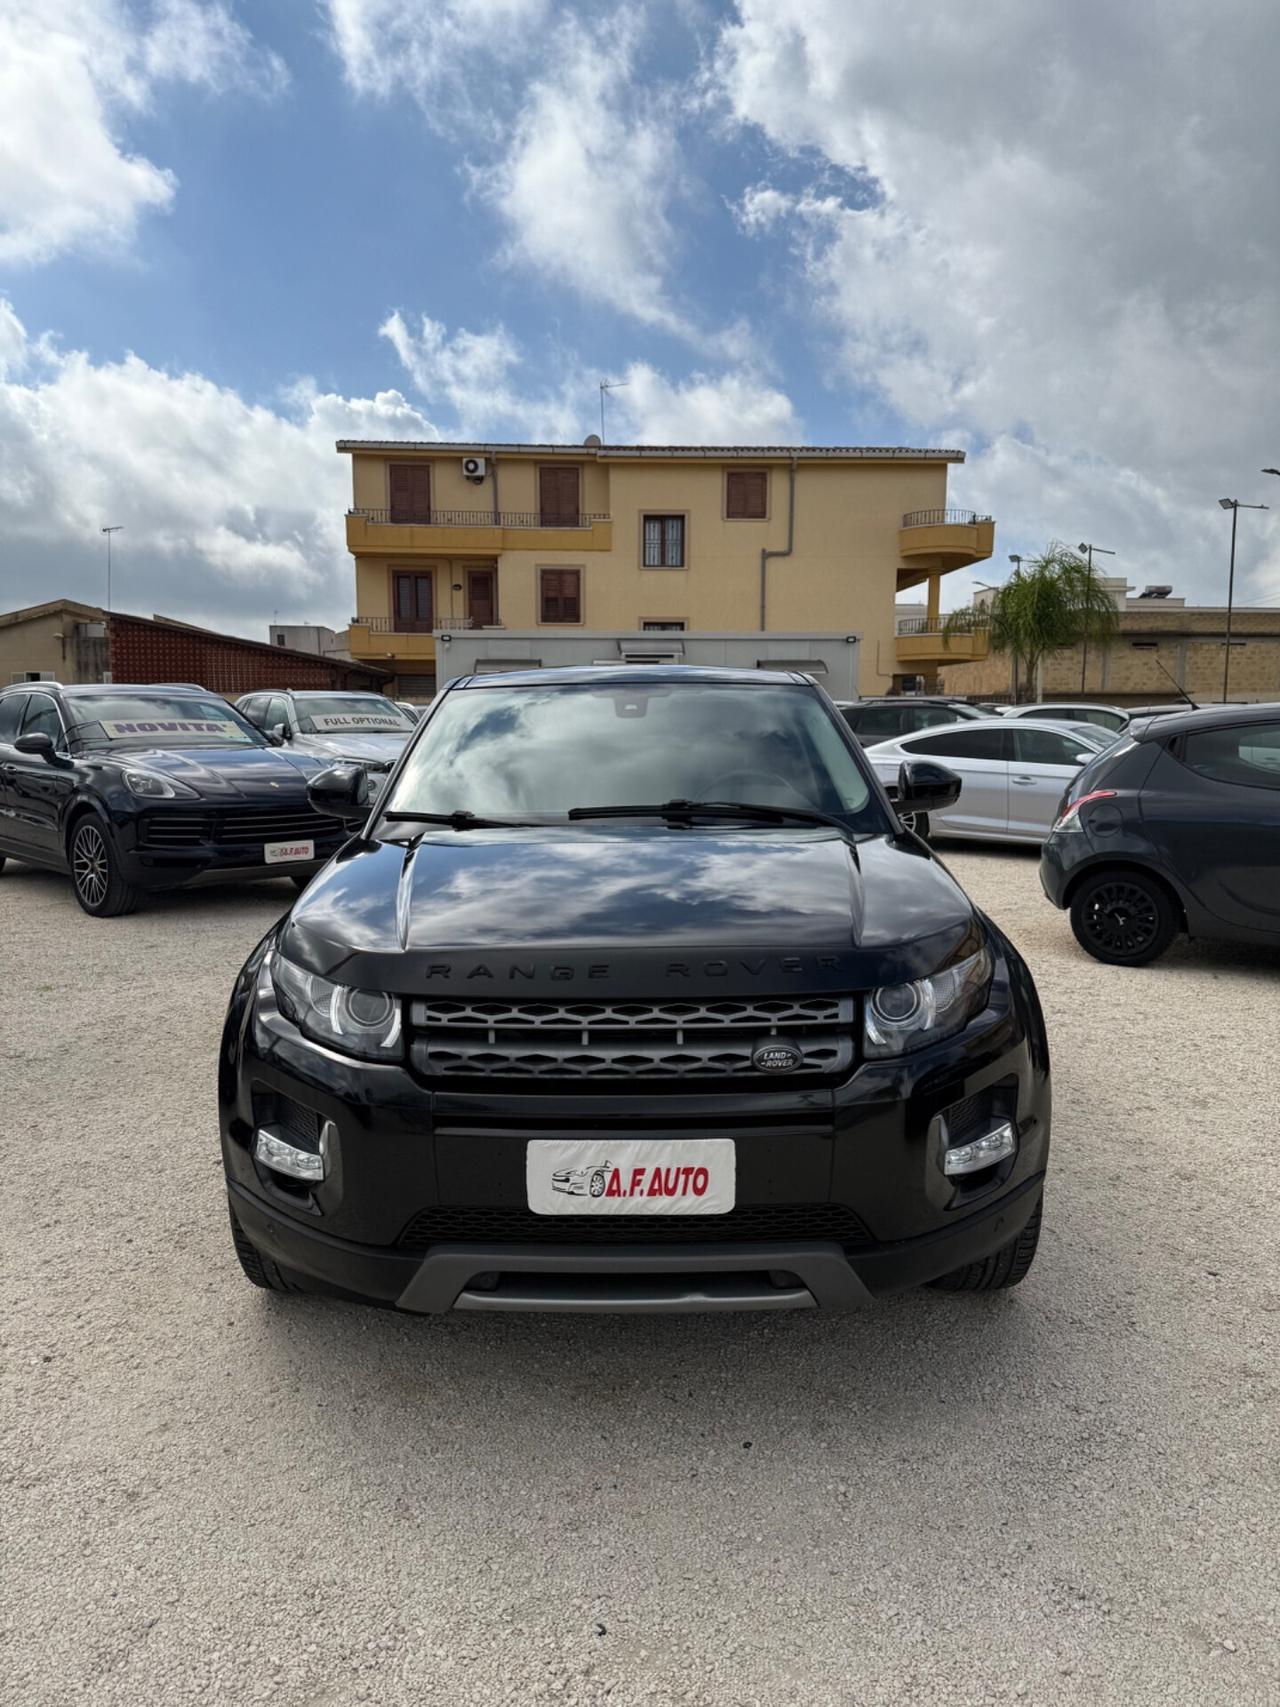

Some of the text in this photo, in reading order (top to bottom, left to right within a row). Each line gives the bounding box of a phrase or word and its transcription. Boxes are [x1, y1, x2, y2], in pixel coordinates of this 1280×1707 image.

[323, 717, 401, 727] FULL OPTIONAL
[425, 954, 842, 980] RANGE ROVER
